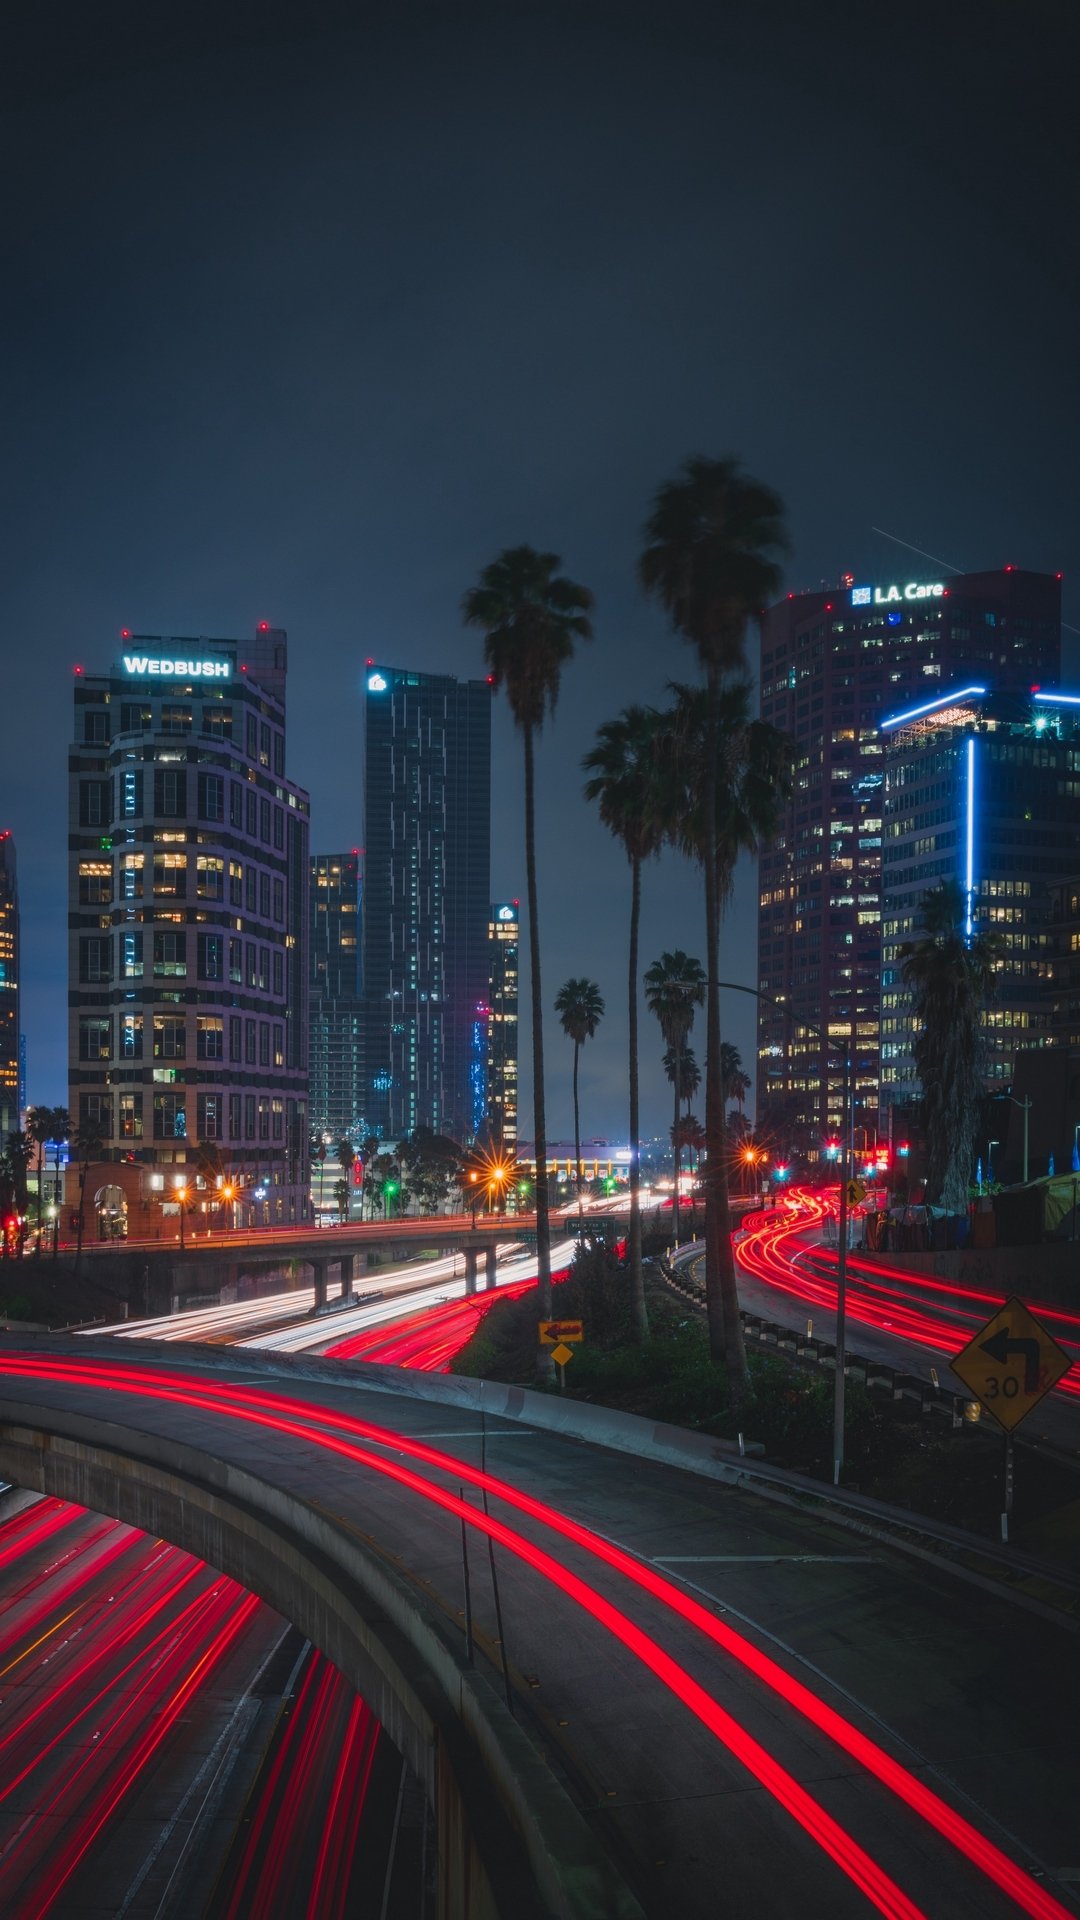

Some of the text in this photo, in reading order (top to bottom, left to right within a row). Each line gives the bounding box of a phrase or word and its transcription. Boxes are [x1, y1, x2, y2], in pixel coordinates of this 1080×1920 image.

[874, 583, 944, 603] L.A. Care
[123, 657, 229, 677] WEDBUSH
[984, 1376, 1019, 1399] 30
